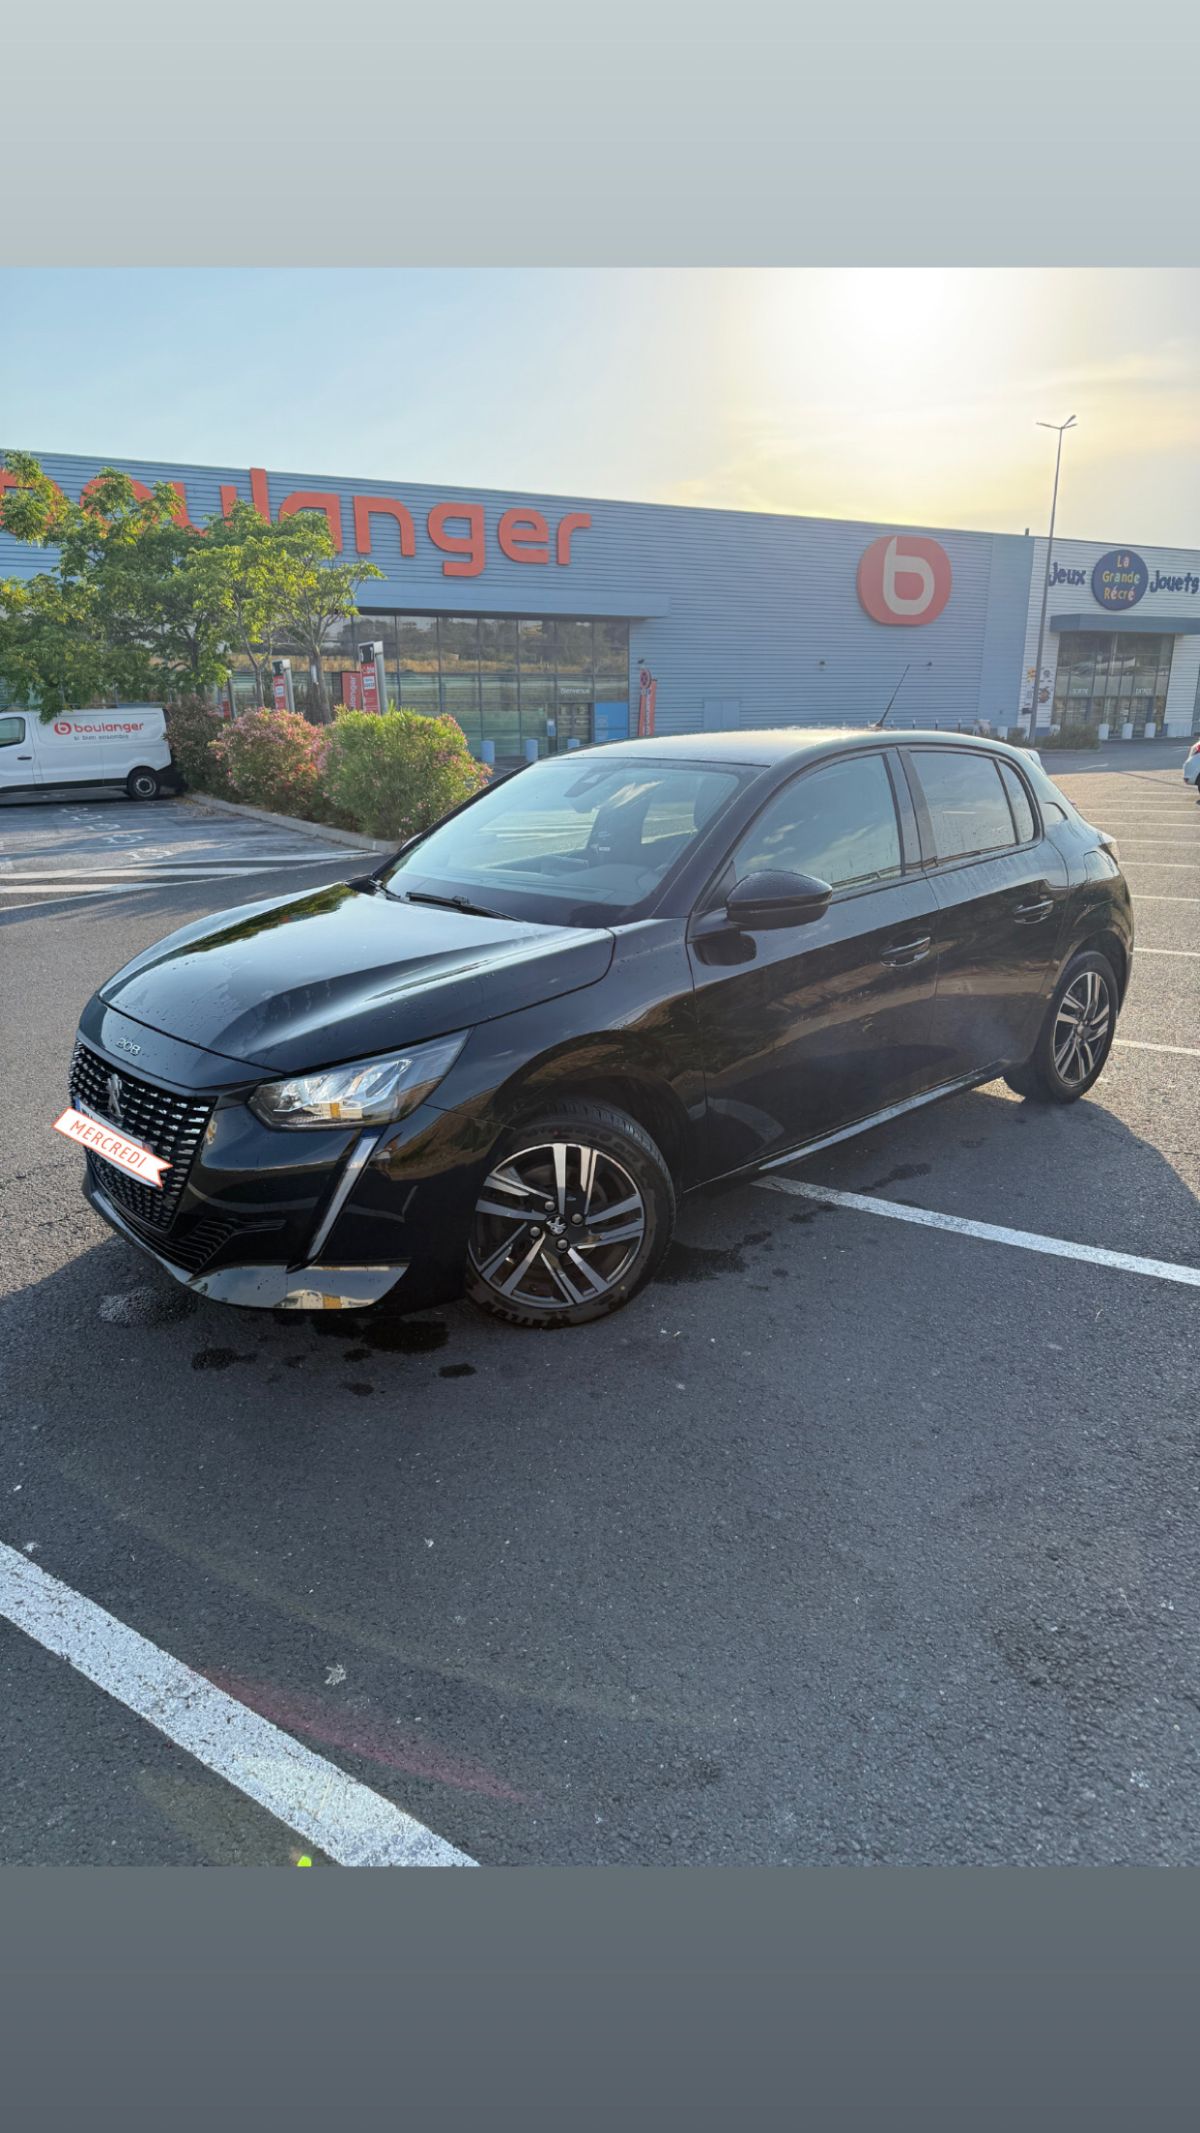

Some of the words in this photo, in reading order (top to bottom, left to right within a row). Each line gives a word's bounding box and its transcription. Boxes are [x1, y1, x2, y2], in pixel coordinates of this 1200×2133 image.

[0, 467, 592, 577] ulanger
[1117, 555, 1131, 568] La
[1048, 562, 1087, 587] Jeux
[1102, 571, 1141, 585] Grande
[1150, 570, 1200, 594] Jouets
[1104, 585, 1136, 601] Récré
[74, 722, 144, 734] boulanger
[115, 1038, 142, 1056] 208
